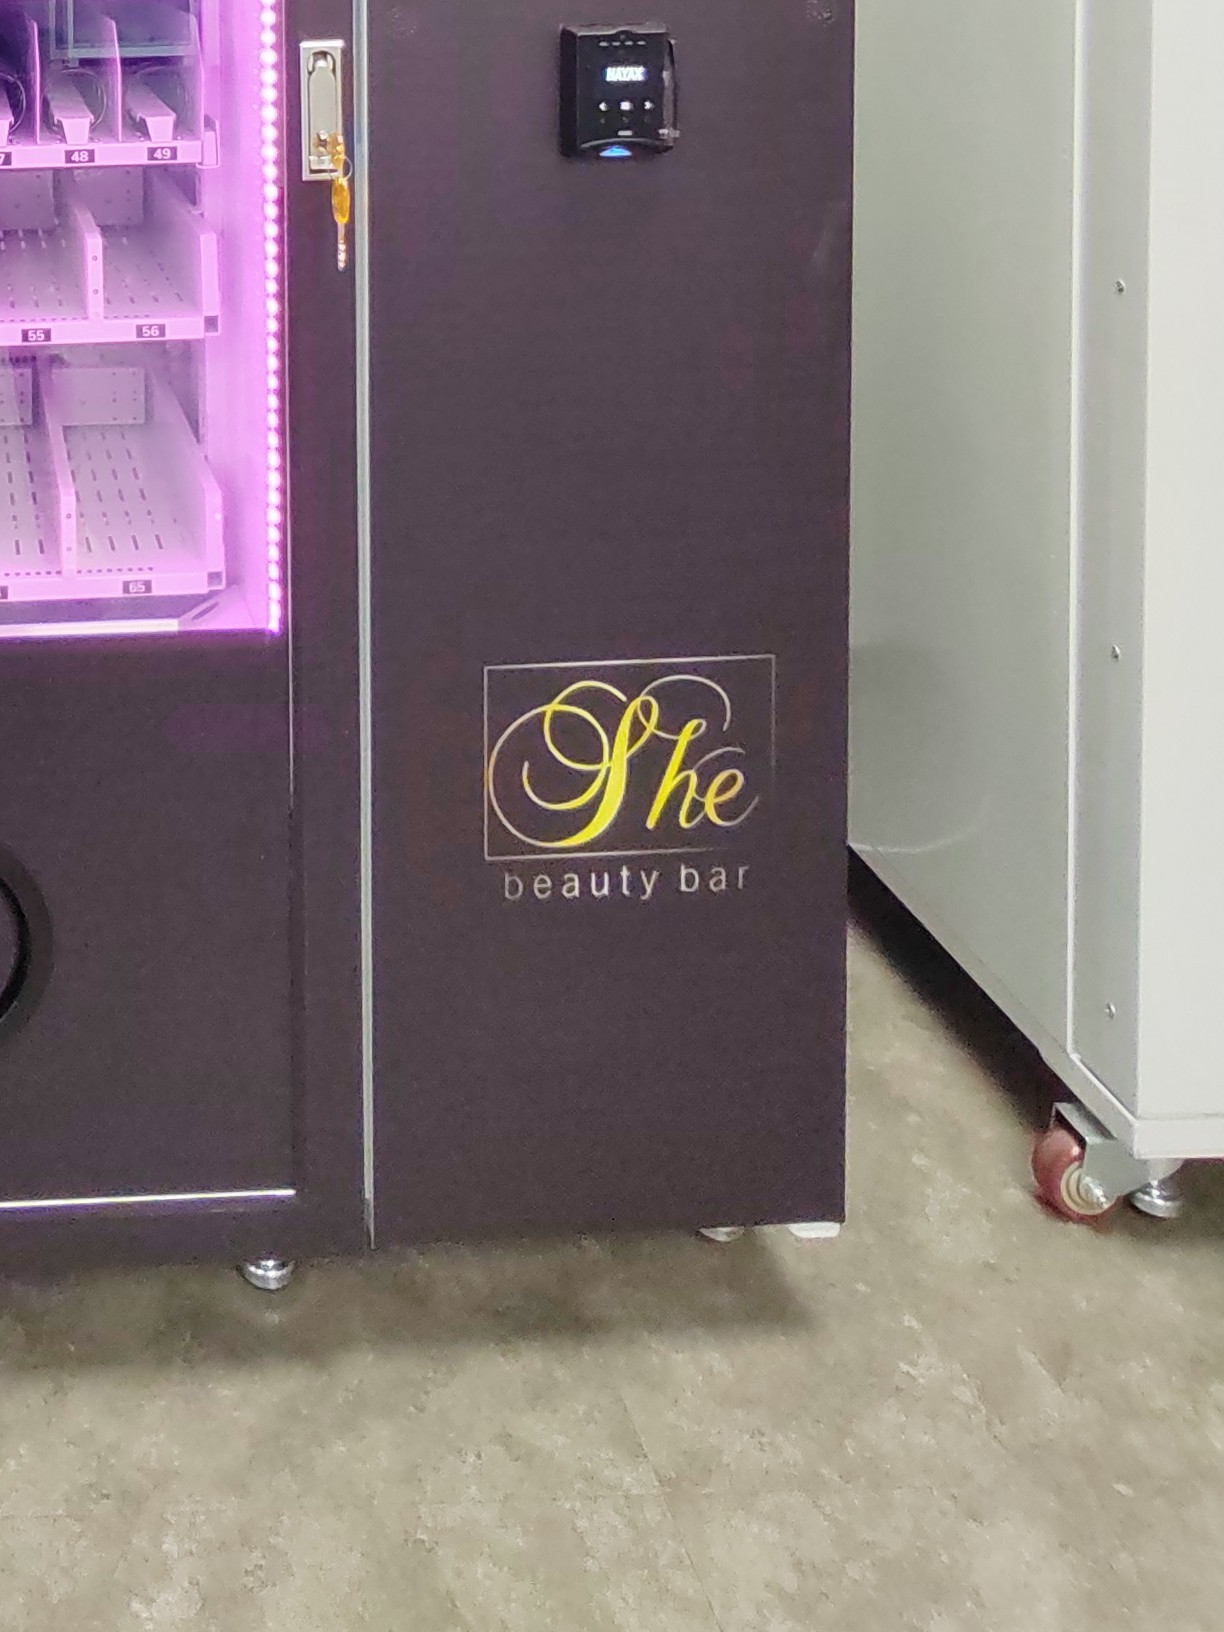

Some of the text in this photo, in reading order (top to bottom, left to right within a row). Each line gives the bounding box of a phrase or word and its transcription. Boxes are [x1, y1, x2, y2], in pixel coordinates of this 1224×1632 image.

[71, 151, 89, 162] 48
[153, 148, 171, 159] 49
[28, 329, 45, 341] 55
[142, 325, 160, 337] 56
[129, 581, 145, 593] 65
[489, 675, 758, 847] She
[504, 864, 750, 900] beauty bar
